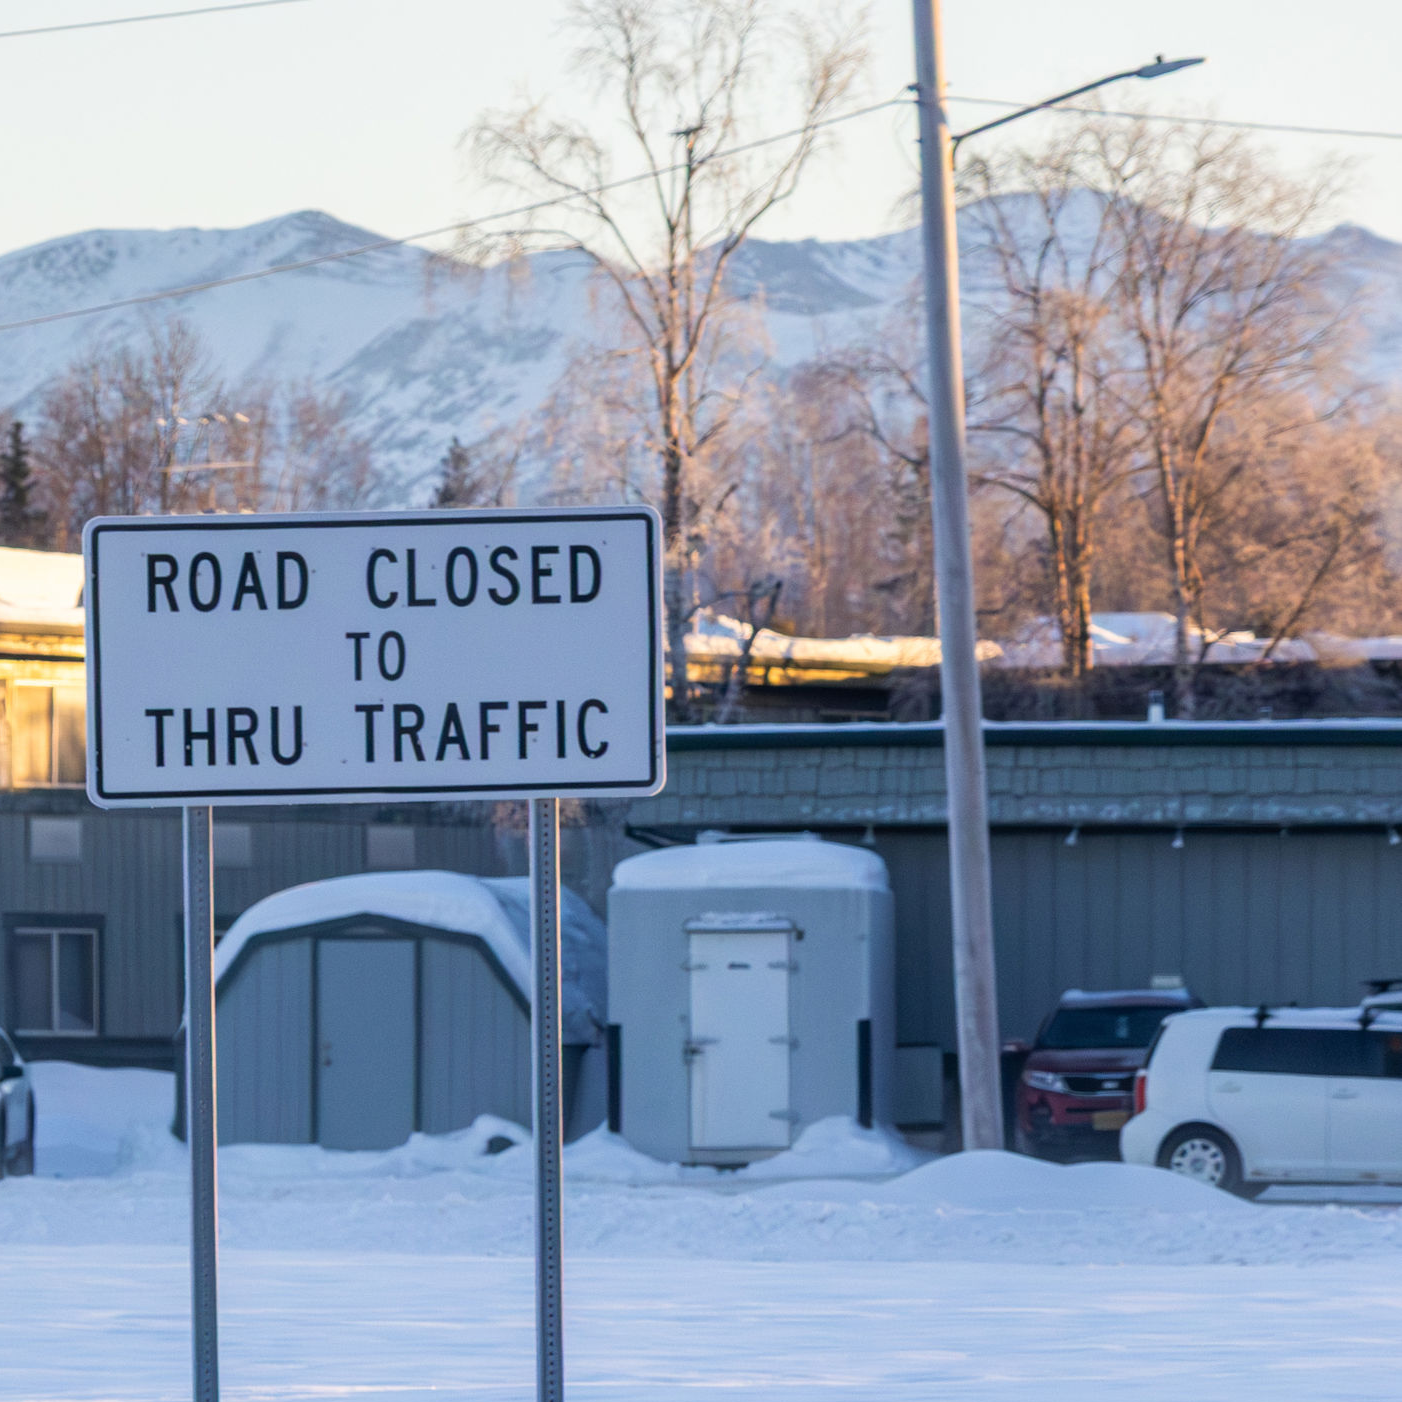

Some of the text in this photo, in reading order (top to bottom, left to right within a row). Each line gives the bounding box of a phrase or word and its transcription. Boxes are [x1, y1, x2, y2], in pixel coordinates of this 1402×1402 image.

[146, 545, 602, 612] ROAD CLOSED
[345, 631, 406, 681] TO
[144, 699, 609, 767] THRU TRAFFIC
